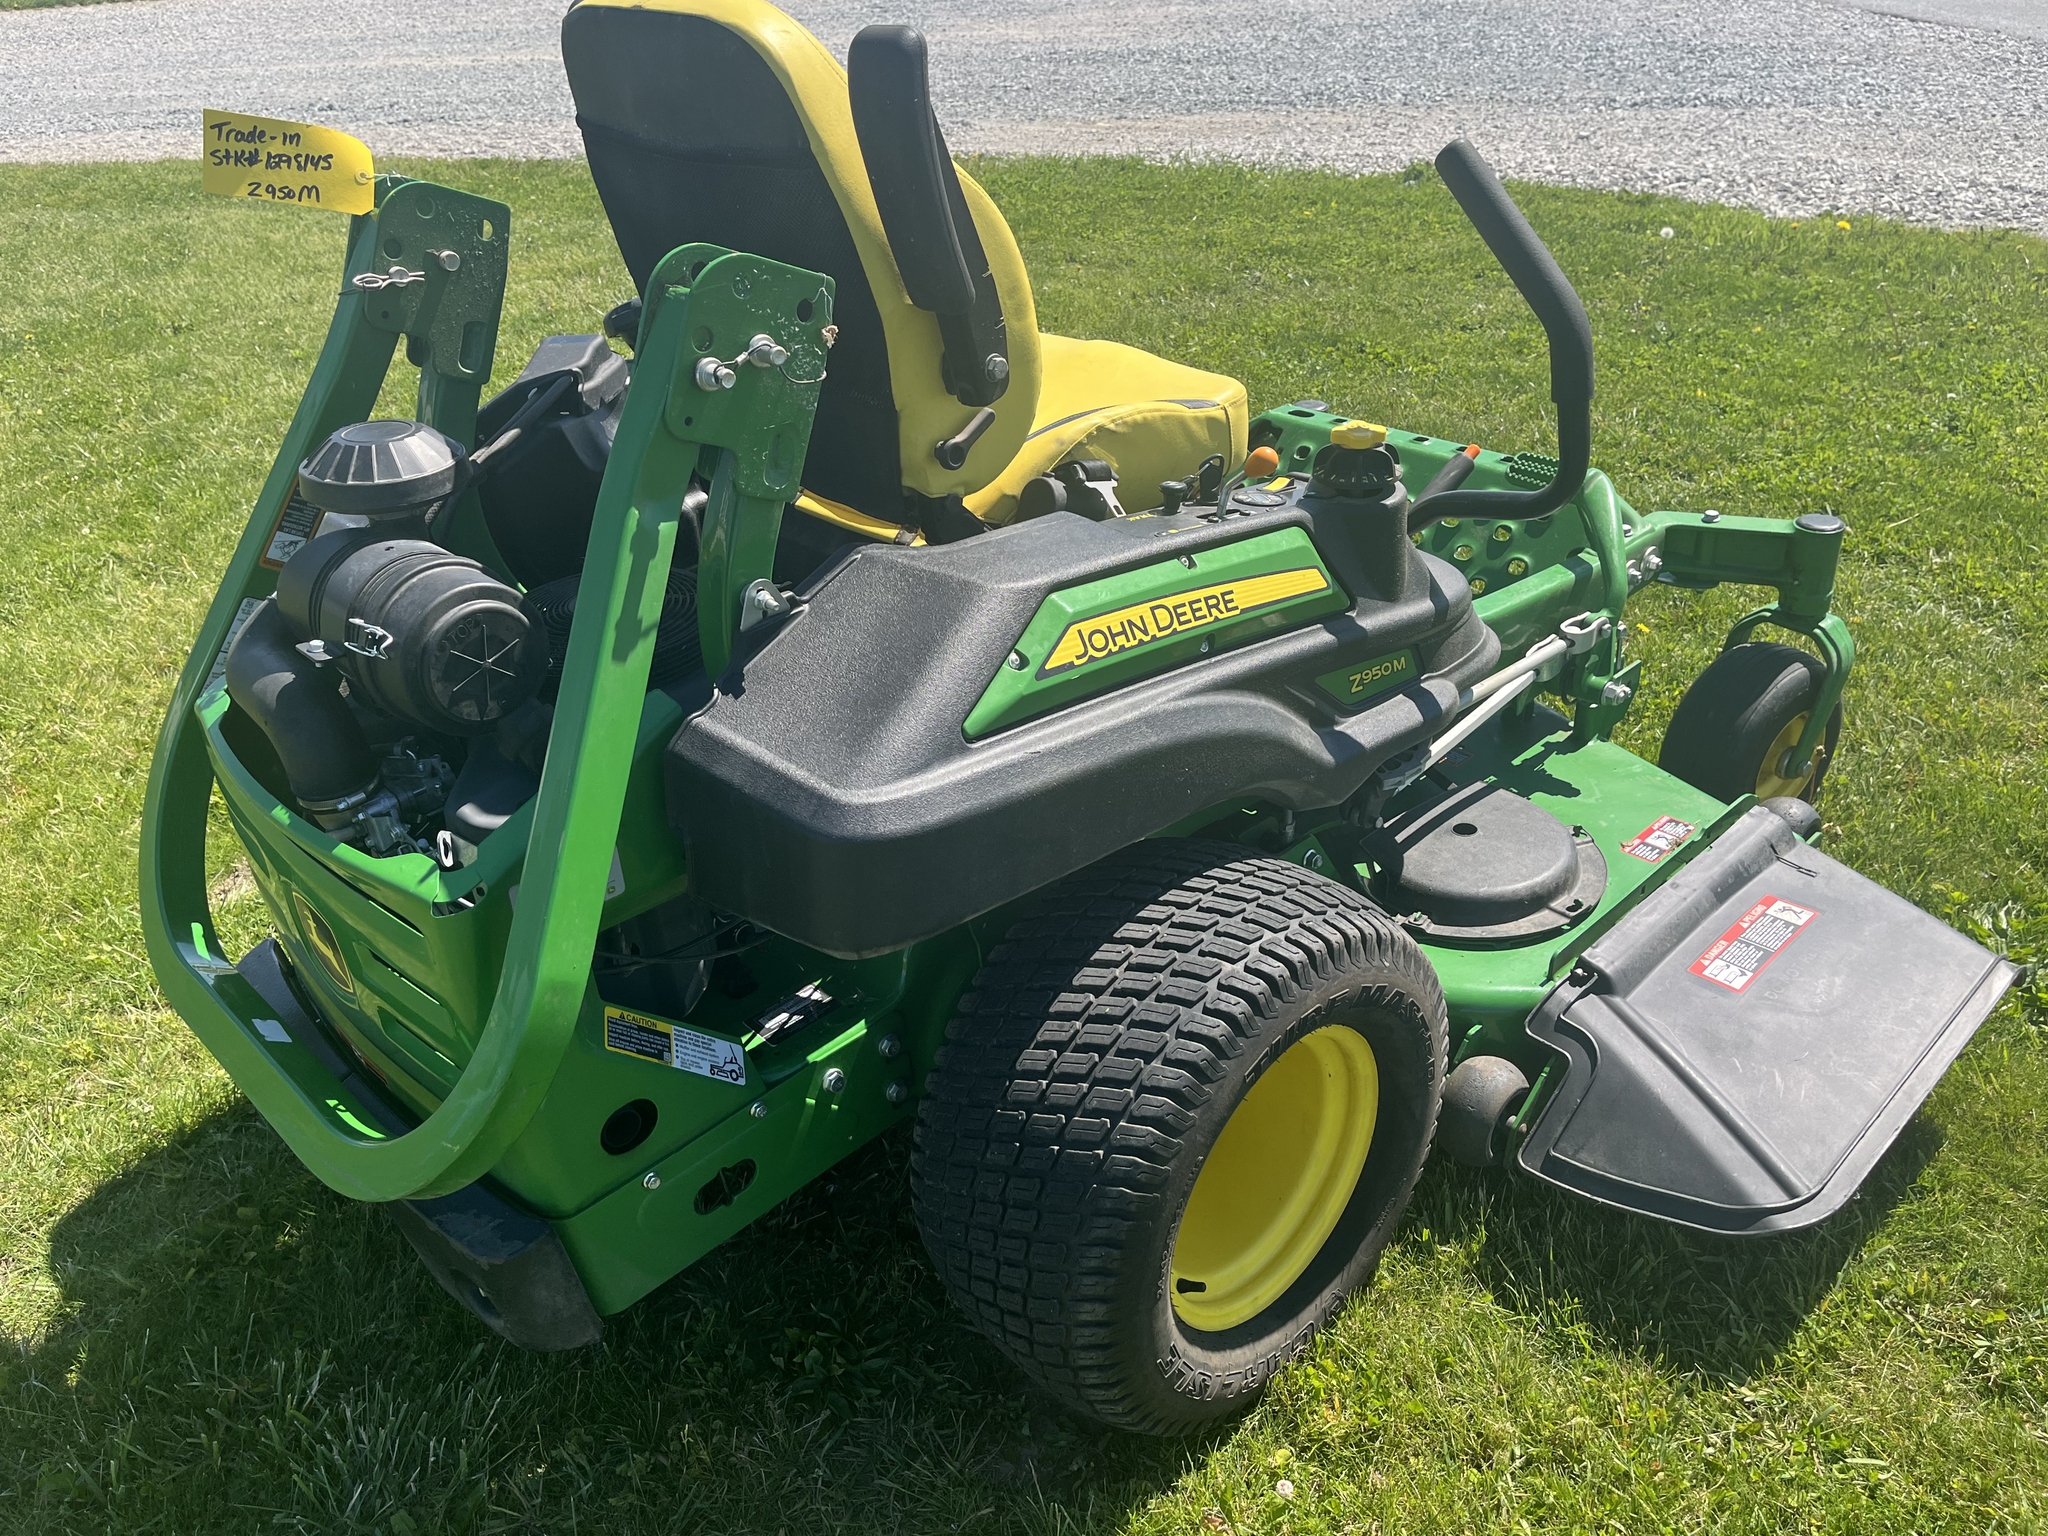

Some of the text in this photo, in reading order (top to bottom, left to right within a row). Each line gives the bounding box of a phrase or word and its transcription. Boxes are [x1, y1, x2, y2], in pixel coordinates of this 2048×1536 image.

[1075, 590, 1239, 660] JOHN DEERE
[1349, 656, 1406, 694] Z950M
[1742, 904, 1768, 924] PELIGRO
[1703, 939, 1729, 960] DANGER
[625, 1013, 658, 1029] CAUTION
